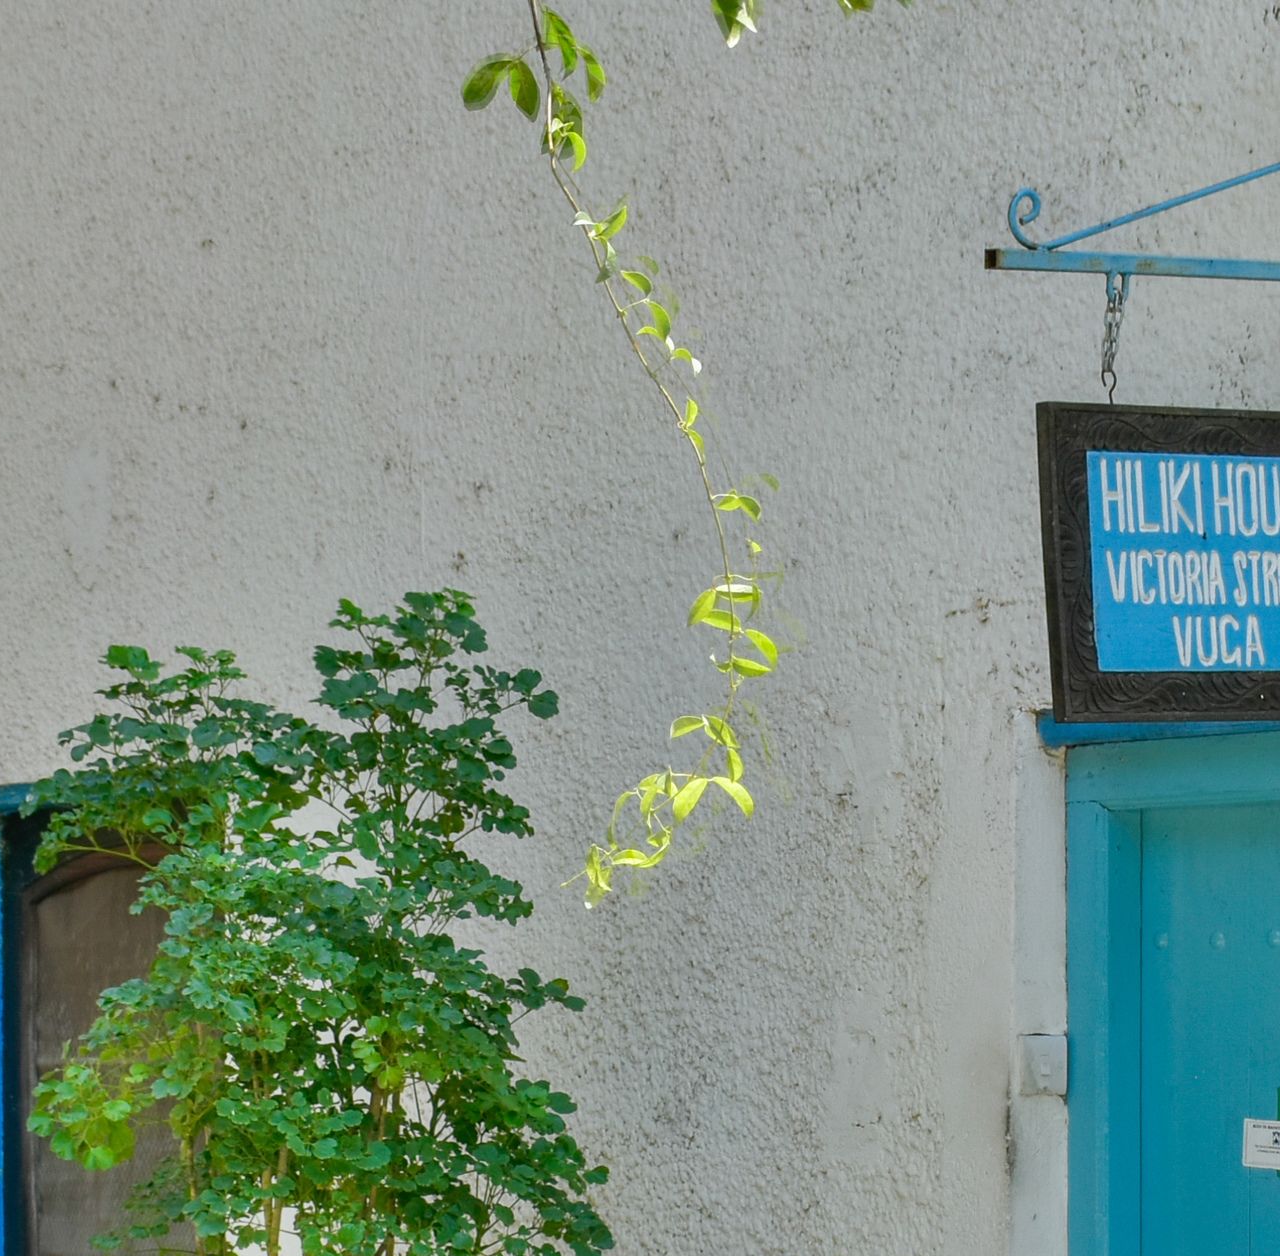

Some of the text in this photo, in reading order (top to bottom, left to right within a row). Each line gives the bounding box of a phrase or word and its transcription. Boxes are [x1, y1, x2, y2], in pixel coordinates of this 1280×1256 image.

[1100, 458, 1203, 535] HILIKI
[1105, 549, 1227, 605] VICTORIA
[1172, 614, 1266, 667] VUGA
